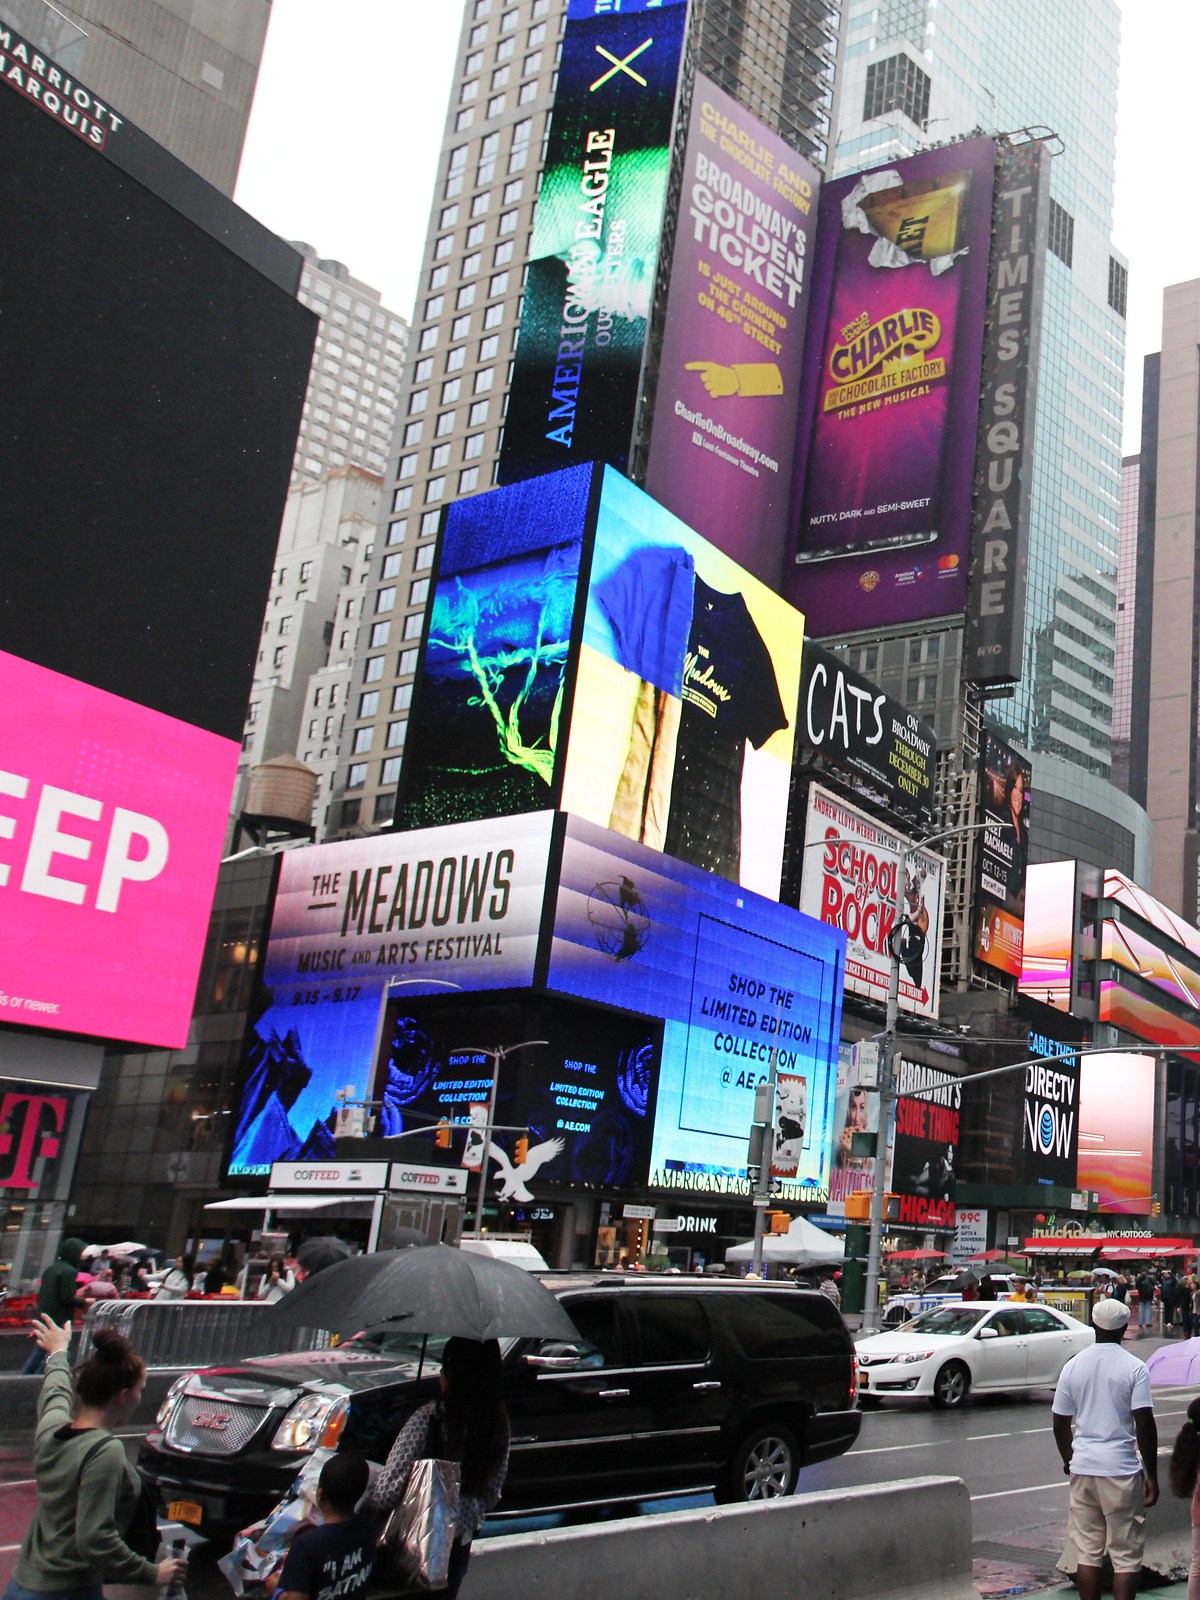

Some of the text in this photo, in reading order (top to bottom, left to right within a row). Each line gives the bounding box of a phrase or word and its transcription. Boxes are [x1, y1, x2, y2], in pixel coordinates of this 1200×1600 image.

[0, 27, 123, 133] MARRIOTT
[700, 119, 812, 216] THE CHOCOLATE FACTORY
[701, 102, 812, 198] CHARLIE AND
[574, 128, 616, 240] EAGLE
[695, 152, 807, 257] BROADWAY'S
[691, 184, 805, 283] GOLDEN
[689, 206, 803, 309] TICKET
[697, 262, 788, 330] IS JUST AROUND
[708, 283, 777, 337] THE CORNER
[697, 292, 715, 313] ON
[743, 318, 783, 356] STREET
[831, 310, 937, 380] CHARLIE
[839, 373, 899, 402] CHOCOLATE
[900, 360, 944, 387] FACTORY
[838, 386, 931, 420] THE NEW MUSICAL
[979, 186, 1033, 617] TIMES SQUARE
[674, 400, 780, 474] CharlieOnBroadway.com
[810, 513, 838, 526] NUTTY,
[839, 508, 863, 521] DARK
[876, 497, 931, 515] SEMI-SWEET
[977, 644, 1003, 658] NYC
[806, 663, 887, 749] CATS
[906, 714, 919, 733] ON
[892, 719, 932, 758] BROADWAY
[894, 739, 926, 771] THROUGH
[888, 751, 922, 783] DECEMBER
[898, 775, 920, 798] ONLY!
[813, 796, 877, 841] ANDREW LLOYD WEBBER
[823, 827, 898, 901] SCHOOL
[982, 858, 1008, 883] OCT 12-15
[312, 872, 342, 897] THE
[340, 849, 515, 937] MEADOWS
[821, 873, 896, 958] ROCK
[297, 932, 503, 974] MUSIC AND ARTS FESTIVAL
[10, 996, 24, 1007] or
[24, 999, 60, 1015] newer.
[728, 974, 794, 1010] SHOP THE
[701, 997, 812, 1044] LIMITED EDITION
[714, 1032, 797, 1069] COLLECTION
[1027, 1031, 1076, 1068] CABLE THEN
[433, 1080, 463, 1091] LIMITED
[438, 1092, 487, 1103] COLLECTION
[550, 1082, 605, 1100] LIMITED EDITION
[556, 1097, 598, 1111] COLLECTION
[900, 1060, 962, 1110] BROADWAY'S
[1025, 1065, 1076, 1106] DIRECTV
[564, 1121, 591, 1133] AE.COM
[897, 1097, 960, 1147] SURE THING
[1024, 1098, 1074, 1159] NOW
[294, 1170, 340, 1181] COFFEED
[401, 1172, 440, 1185] COFFEED
[651, 1168, 722, 1195] AMERICAN
[677, 1215, 717, 1233] DRINK
[1106, 1230, 1152, 1239] NYC HOTDOGS
[191, 1412, 230, 1430] GMC
